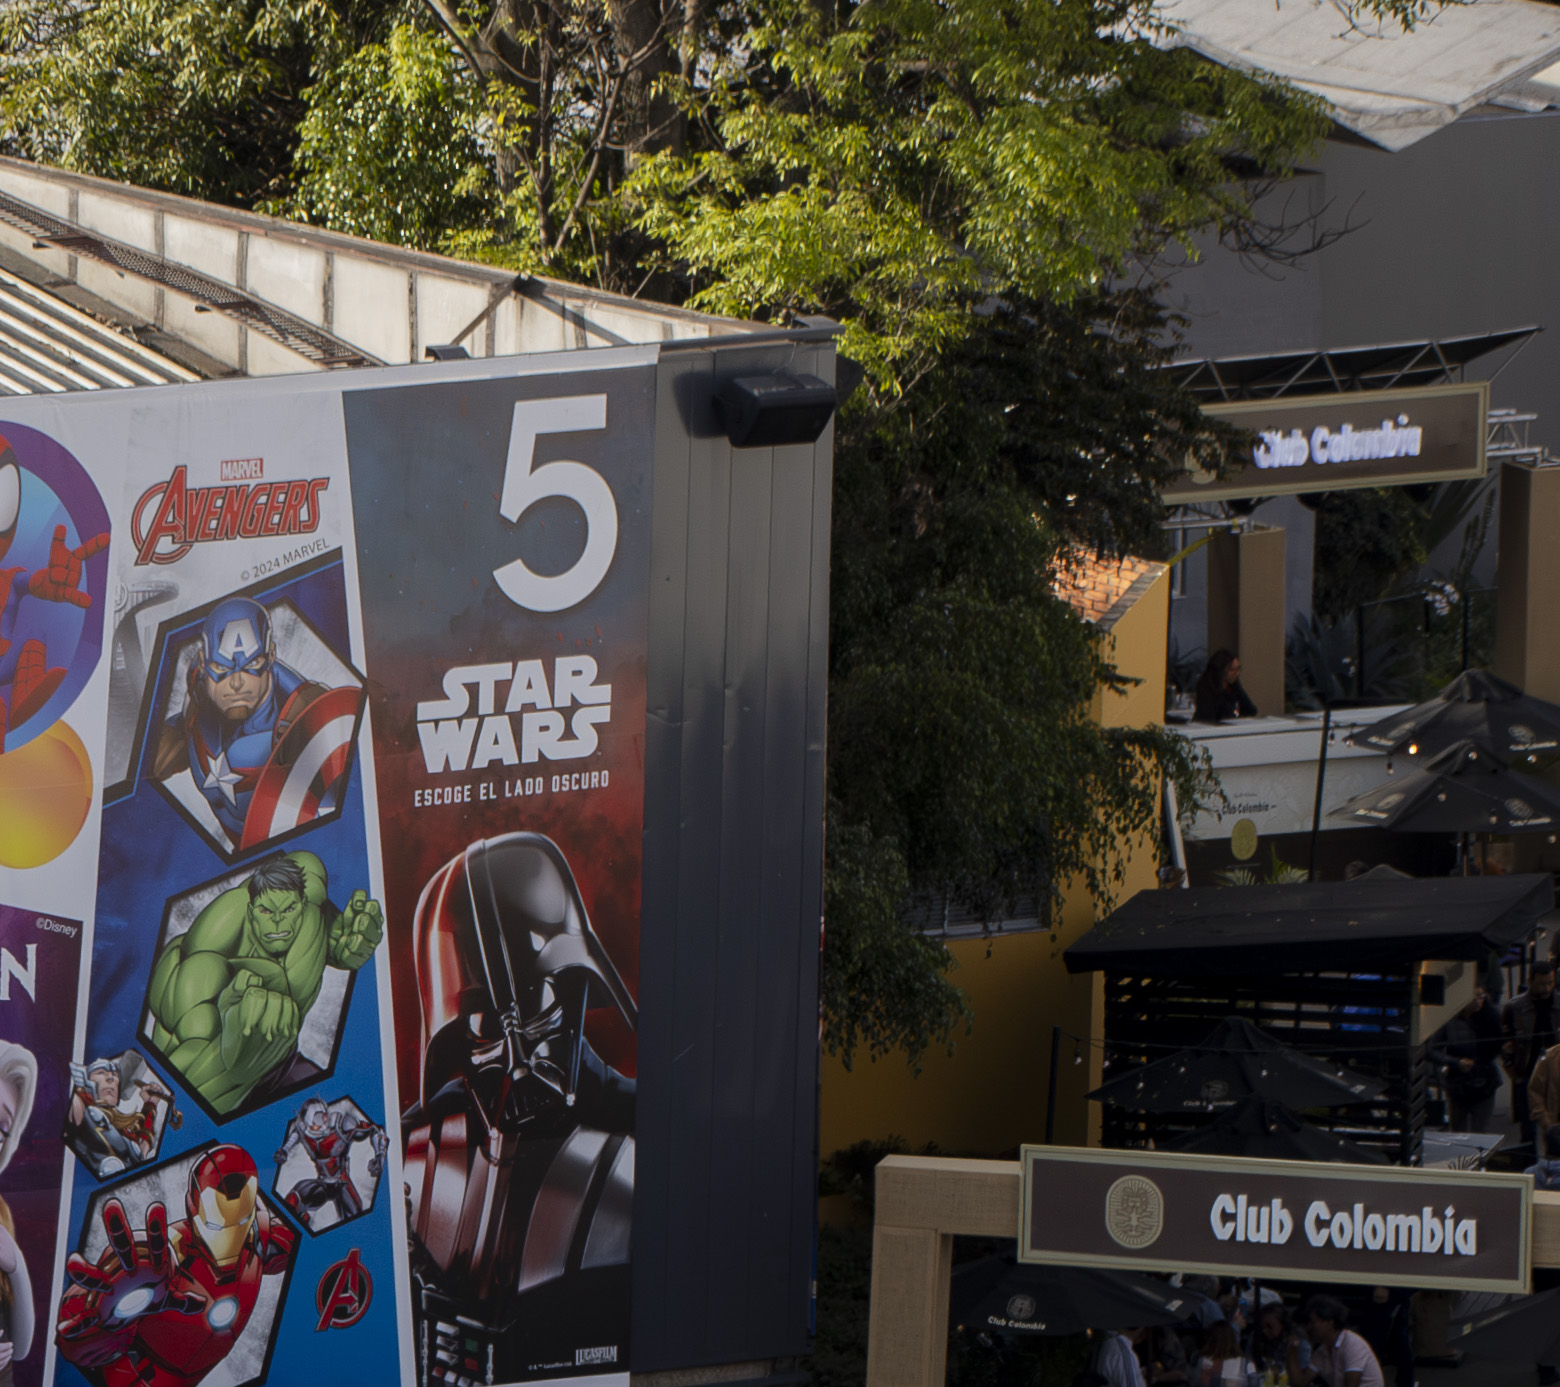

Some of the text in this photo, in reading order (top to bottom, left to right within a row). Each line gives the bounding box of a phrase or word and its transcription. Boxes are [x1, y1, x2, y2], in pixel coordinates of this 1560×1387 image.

[131, 464, 330, 567] AVENGERS
[492, 394, 618, 613] 5
[283, 539, 330, 568] MARVEL
[417, 654, 611, 723] STAR
[417, 705, 610, 773] WARS
[414, 770, 609, 808] ESCOGE EL LADO OSCURO
[1210, 1193, 1477, 1258] Club Colombia
[987, 1315, 1007, 1327] Club
